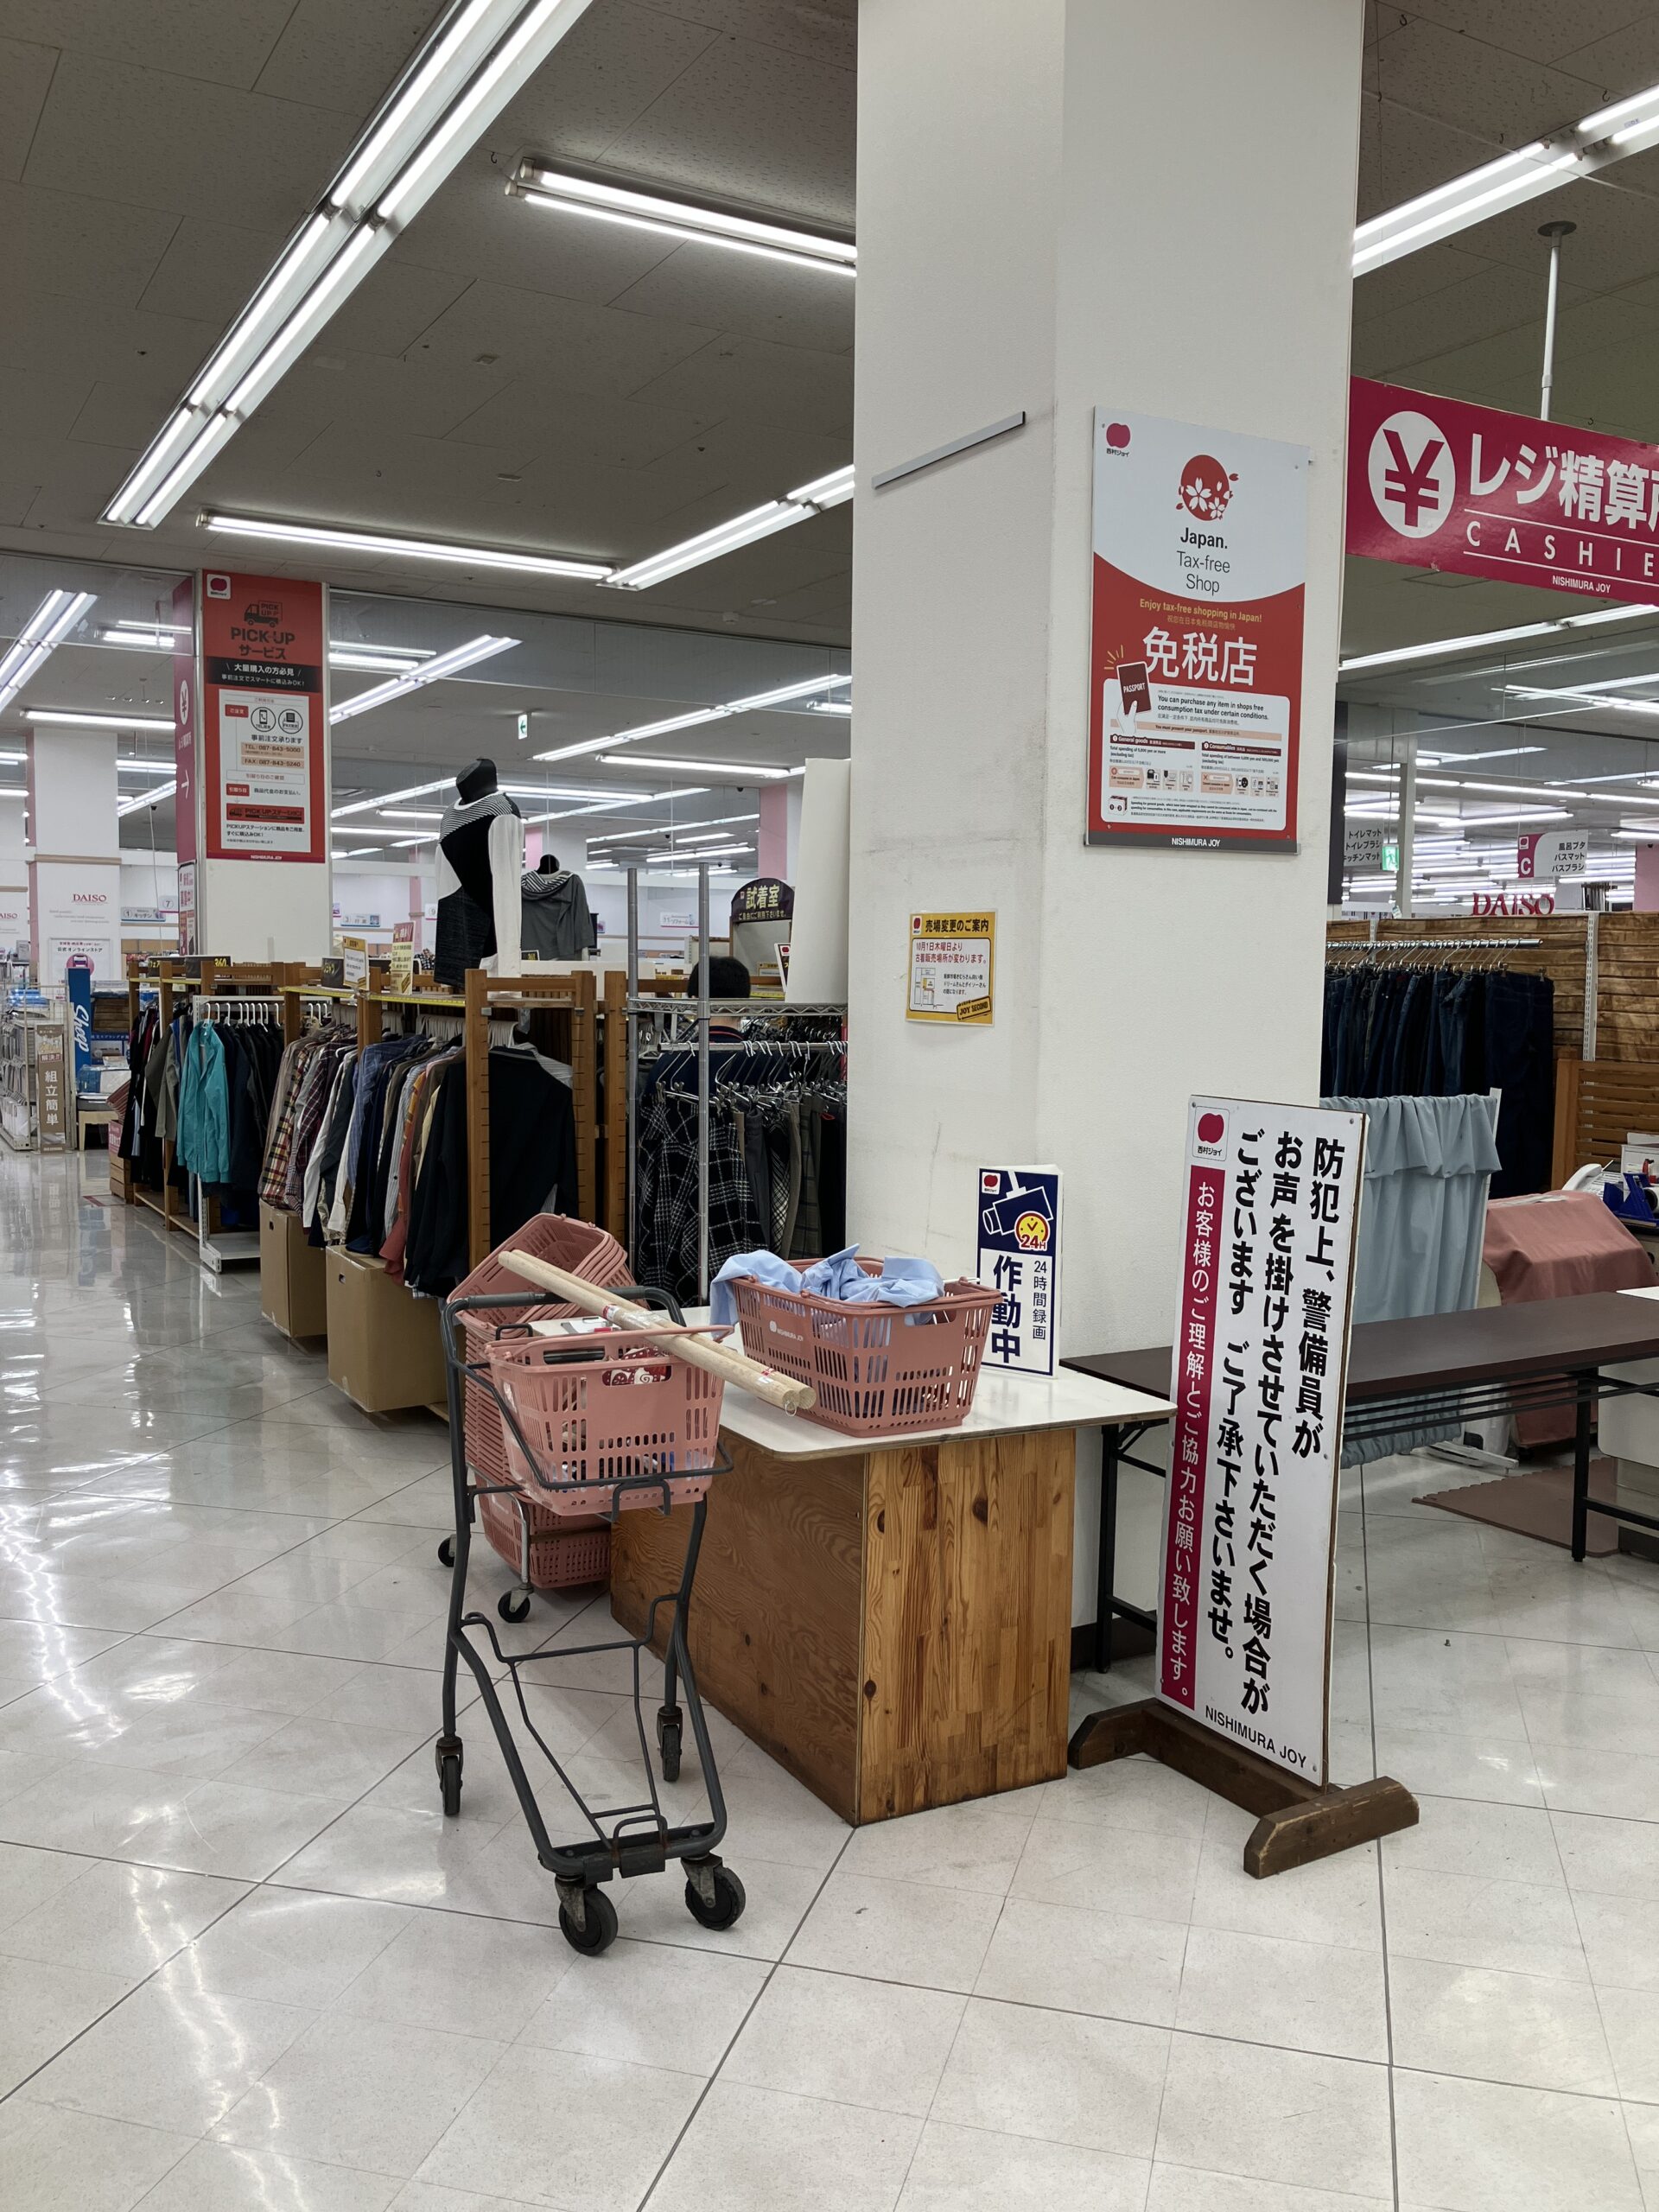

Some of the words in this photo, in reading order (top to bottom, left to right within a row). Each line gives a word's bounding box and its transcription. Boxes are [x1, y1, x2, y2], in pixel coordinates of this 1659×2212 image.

[1470, 433, 1659, 532] レジ精算
[1180, 527, 1228, 549] Japan.
[1177, 550, 1230, 574] Tax-free
[1185, 574, 1220, 596] Shop
[1552, 575, 1595, 592] NISHIMURA
[1595, 582, 1611, 594] JOY
[1140, 598, 1161, 612] Enjoy
[1163, 602, 1192, 613] tax-free
[1193, 606, 1228, 620] shopping
[1230, 611, 1236, 620] in
[1238, 612, 1262, 623] Japan!
[238, 644, 286, 660] サービス
[1142, 626, 1257, 686] 免税店
[234, 663, 295, 677] 大量購入の方必見
[1123, 683, 1146, 693] PASSPORT
[1158, 705, 1193, 715] consumption
[1221, 709, 1239, 718] certain
[1240, 711, 1269, 720] conditions.
[1180, 697, 1205, 707] purchase
[1236, 702, 1252, 711] shops
[1171, 837, 1207, 847] NISHIMURA
[1349, 829, 1382, 839] トイレマット
[1521, 857, 1531, 874] C
[1554, 853, 1585, 861] バスマット
[1552, 863, 1585, 873] バスブラシ
[73, 893, 107, 902] DAISO
[746, 884, 780, 910] 試着室
[1471, 893, 1554, 916] DAISO
[925, 918, 989, 933] 売場変更のご案内
[916, 942, 963, 951] 10月1日木曜日より
[959, 1007, 971, 1015] JOY
[44, 1070, 60, 1126] 組立簡単
[1198, 1145, 1223, 1157] 西村ジョイ
[1020, 1234, 1046, 1250] 24H
[1032, 1260, 1047, 1340] 24時間録画
[1291, 1137, 1345, 1459] 防犯上、警備員が
[991, 1255, 1023, 1363] 作動中
[1241, 1130, 1304, 1715] お声を掛けさせていただく場合が
[1170, 1181, 1215, 1697] お客様のご理解とご協力お願い致します。
[1205, 1704, 1275, 1754] NISHIMURA
[1280, 1745, 1307, 1770] JOY
